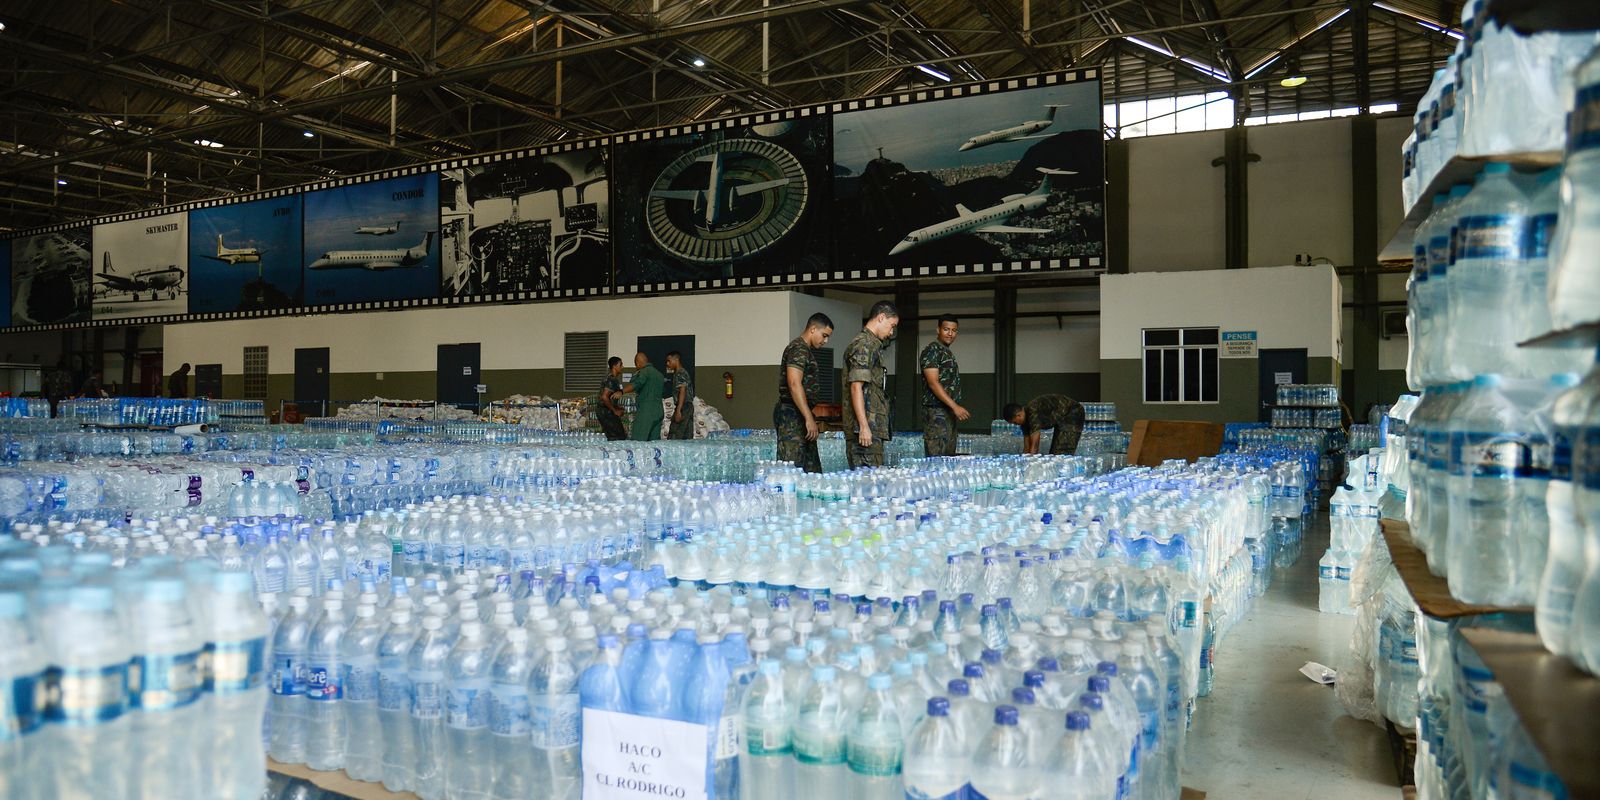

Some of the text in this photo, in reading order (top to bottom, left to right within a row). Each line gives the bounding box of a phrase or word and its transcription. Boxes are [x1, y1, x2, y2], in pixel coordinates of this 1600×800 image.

[392, 188, 424, 202] CONDOR
[272, 207, 291, 217] AVRO
[145, 223, 179, 236] SKYMASTER
[619, 742, 662, 758] HACO
[628, 761, 651, 775] A/C
[595, 772, 686, 799] CL RODRIGO
